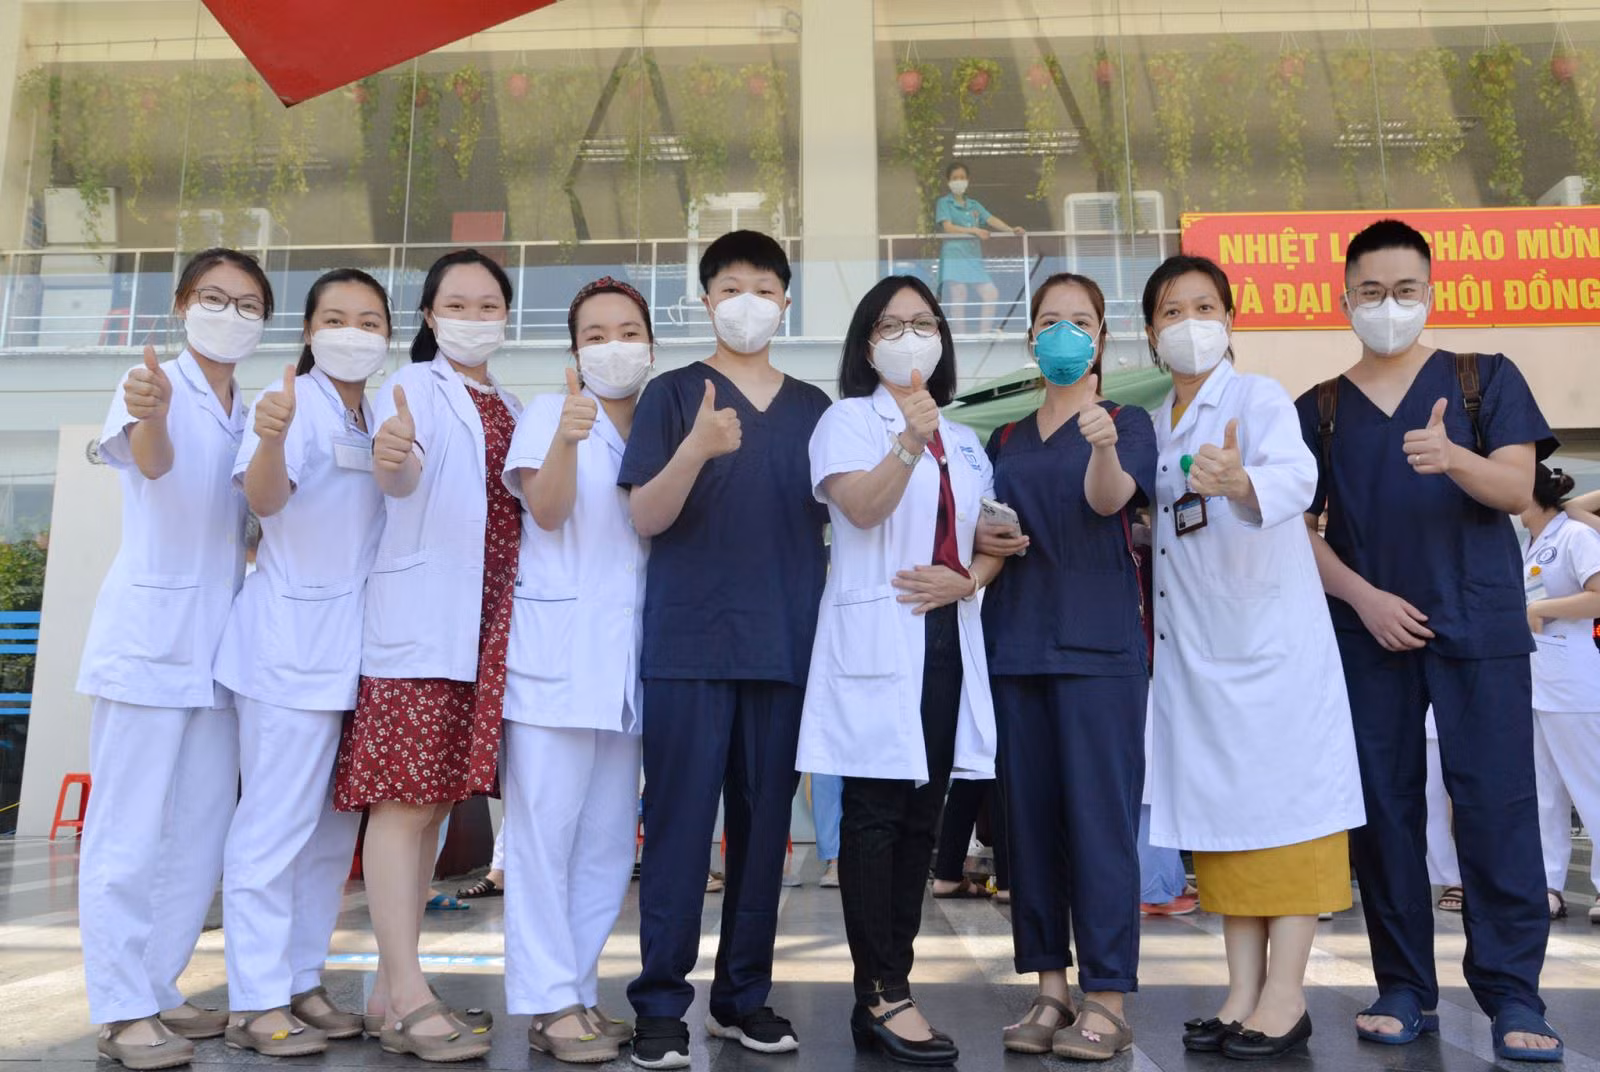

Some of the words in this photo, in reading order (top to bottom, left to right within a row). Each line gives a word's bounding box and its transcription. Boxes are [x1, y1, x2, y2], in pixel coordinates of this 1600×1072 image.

[1219, 226, 1319, 270] NHIỆT
[1273, 282, 1332, 320] ĐẠI
[1434, 274, 1494, 318] HỘI
[1504, 269, 1600, 311] ĐỒNG
